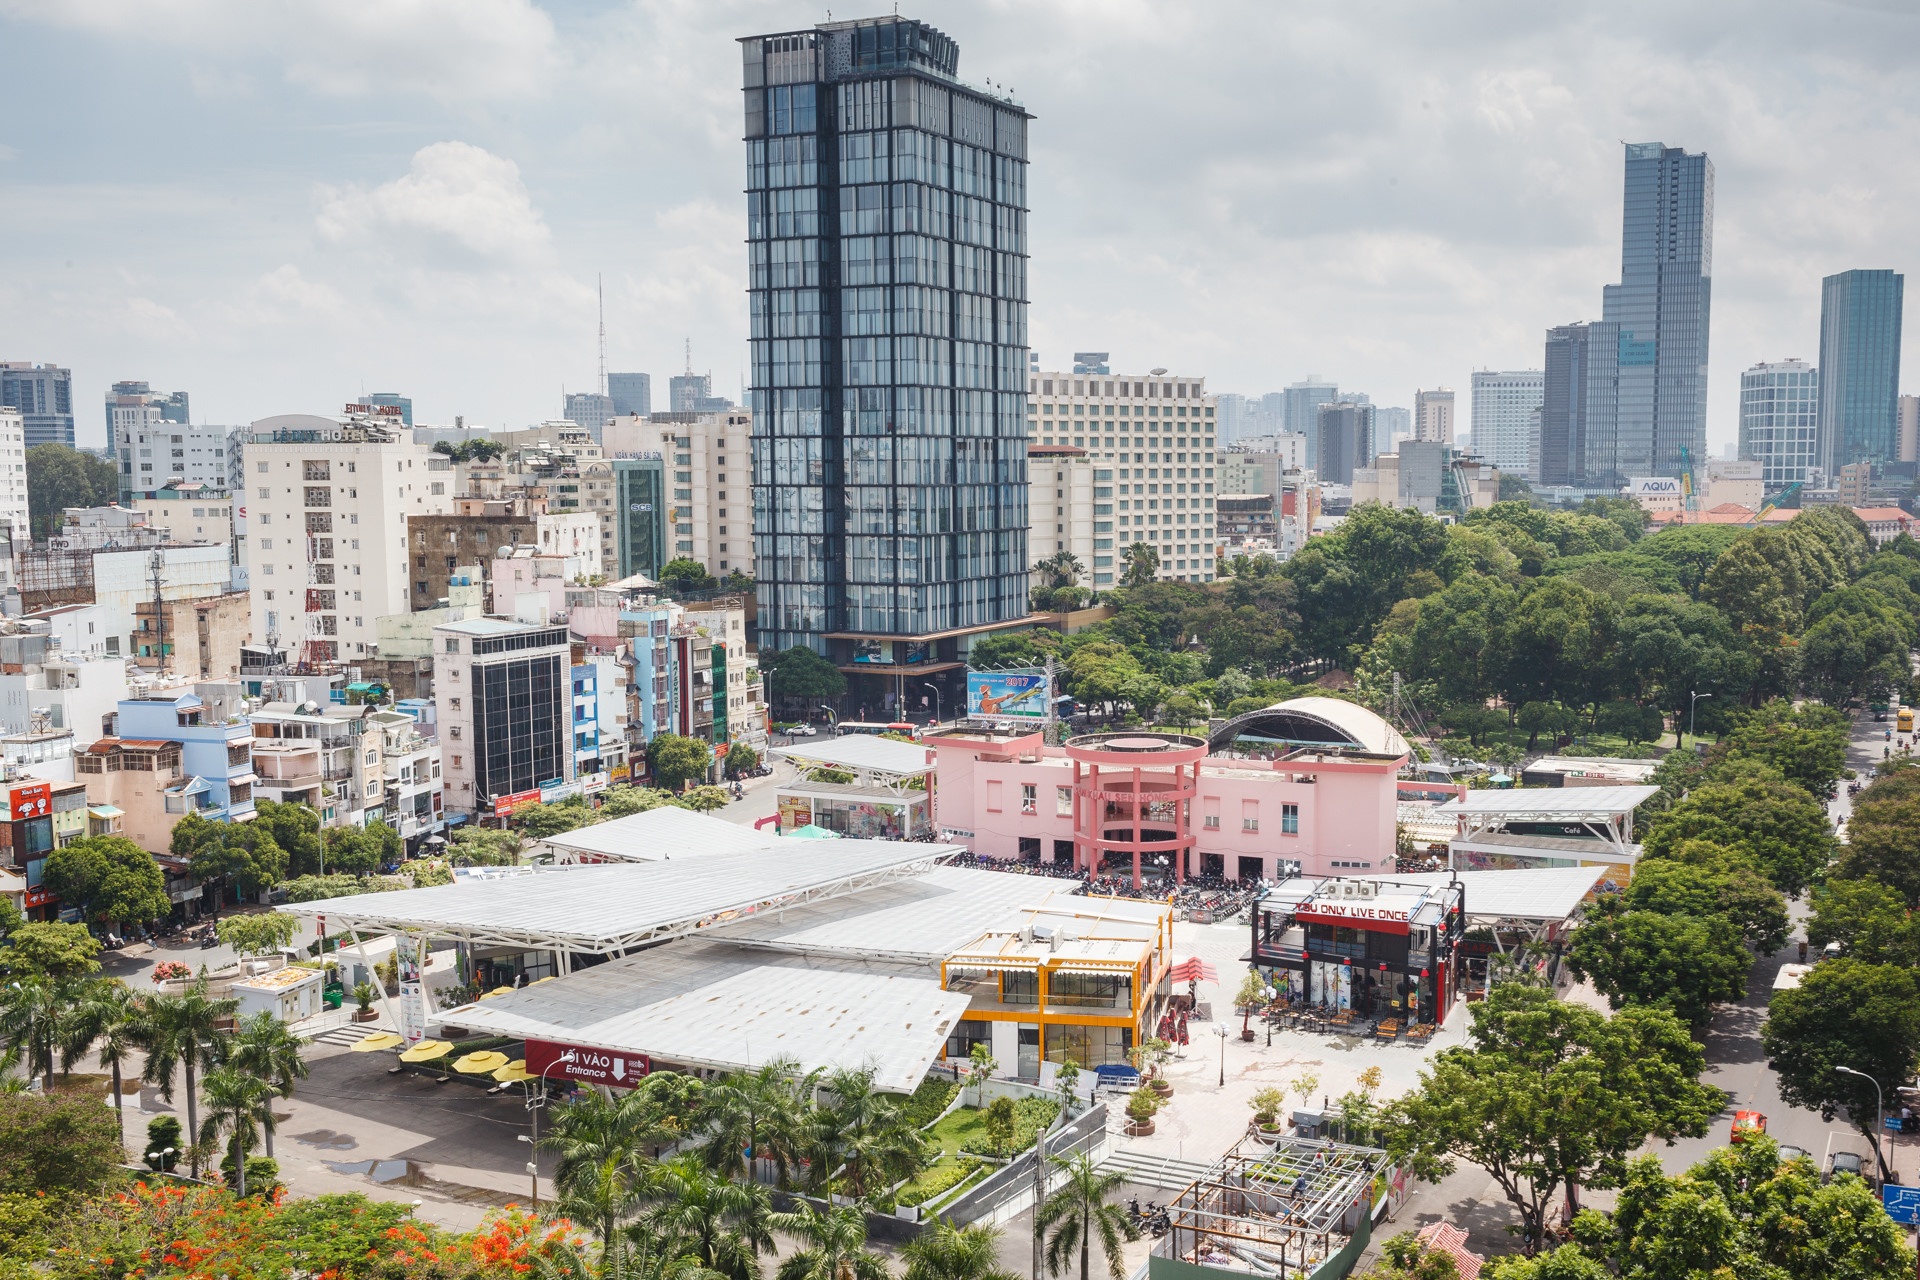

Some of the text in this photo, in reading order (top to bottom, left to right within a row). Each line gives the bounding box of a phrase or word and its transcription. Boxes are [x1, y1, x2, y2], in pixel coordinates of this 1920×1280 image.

[379, 405, 402, 415] HOTEL
[320, 430, 369, 441] HOTEL
[1642, 482, 1676, 491] AQUA
[630, 503, 653, 511] SCB
[1006, 677, 1028, 687] 2017
[1564, 826, 1580, 834] Café
[1295, 902, 1408, 920] YOU ONLY LIVE ONCE
[582, 1052, 610, 1068] VÀO
[566, 1064, 606, 1078] Entrance
